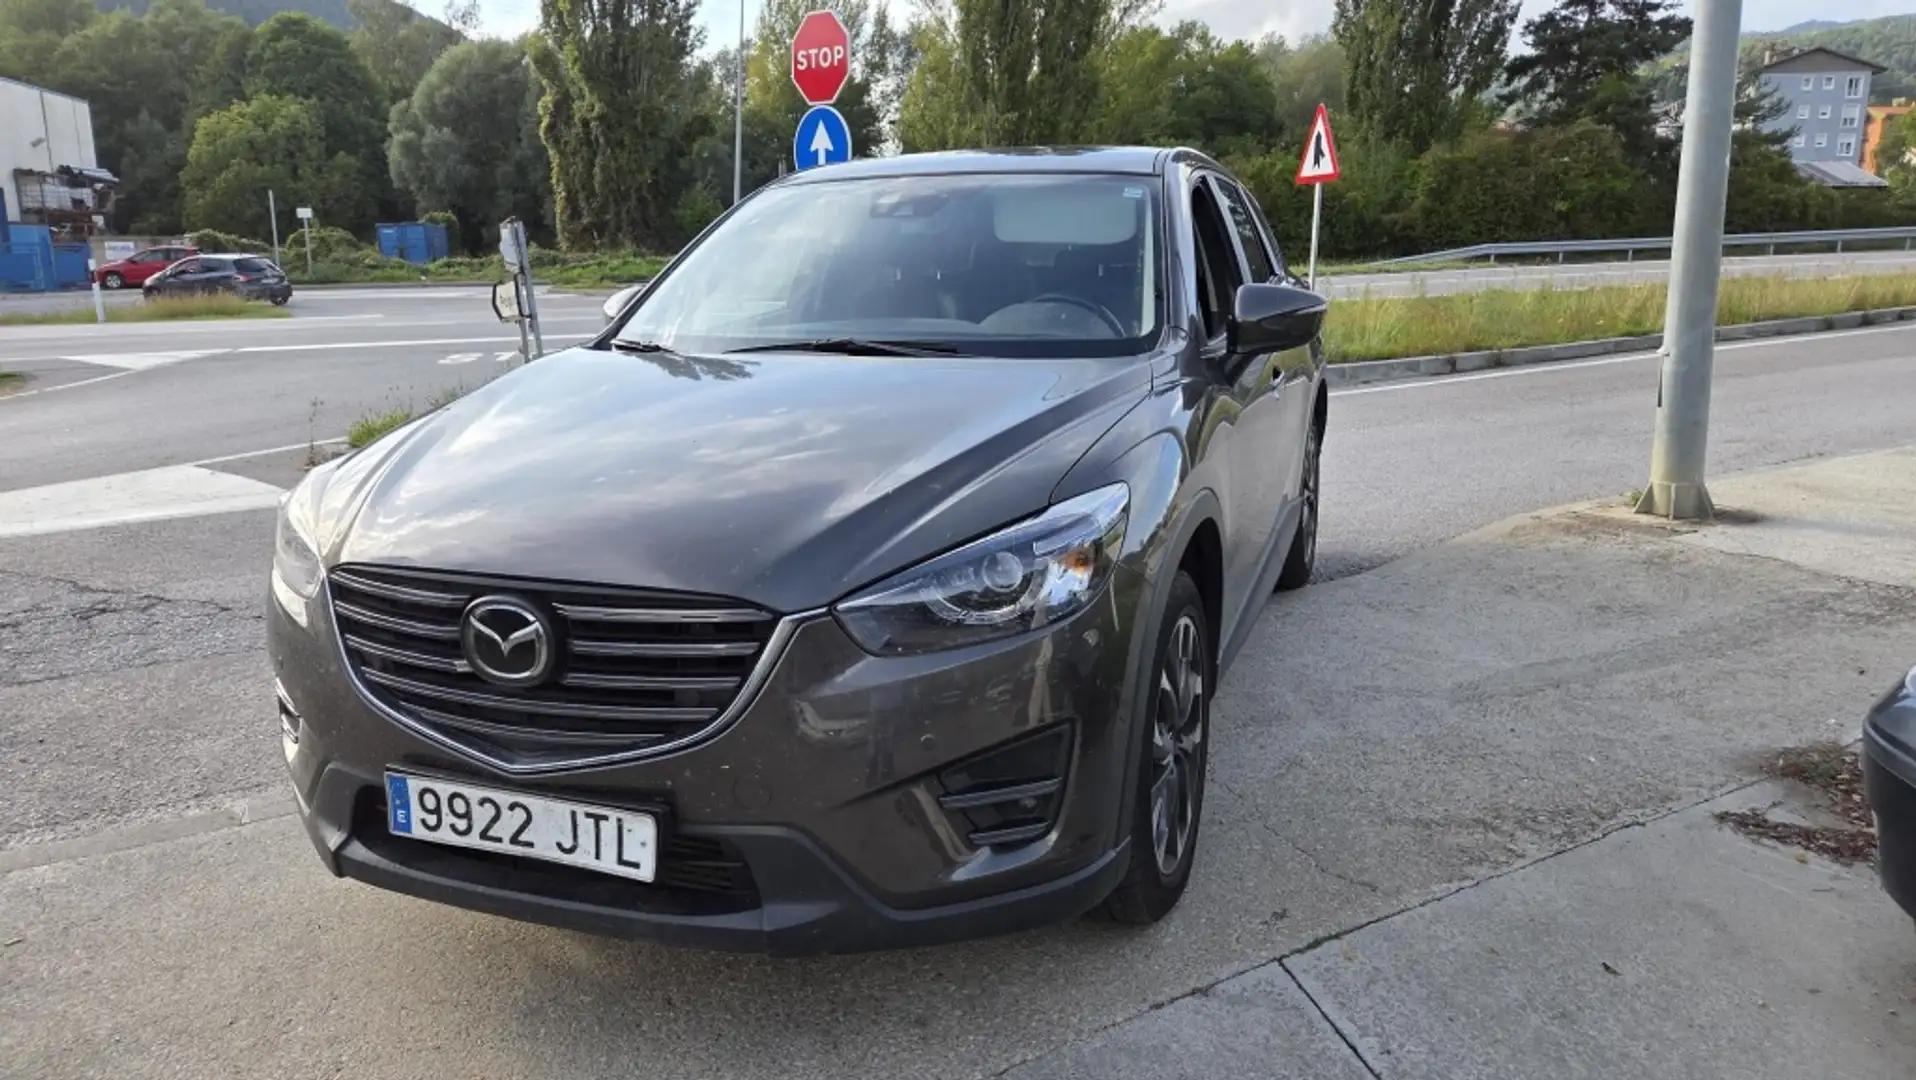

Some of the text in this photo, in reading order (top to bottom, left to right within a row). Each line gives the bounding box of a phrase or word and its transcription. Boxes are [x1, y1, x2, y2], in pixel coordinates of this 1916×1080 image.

[797, 45, 844, 70] STOP
[397, 809, 408, 823] E
[418, 787, 640, 869] 9922 JTL
